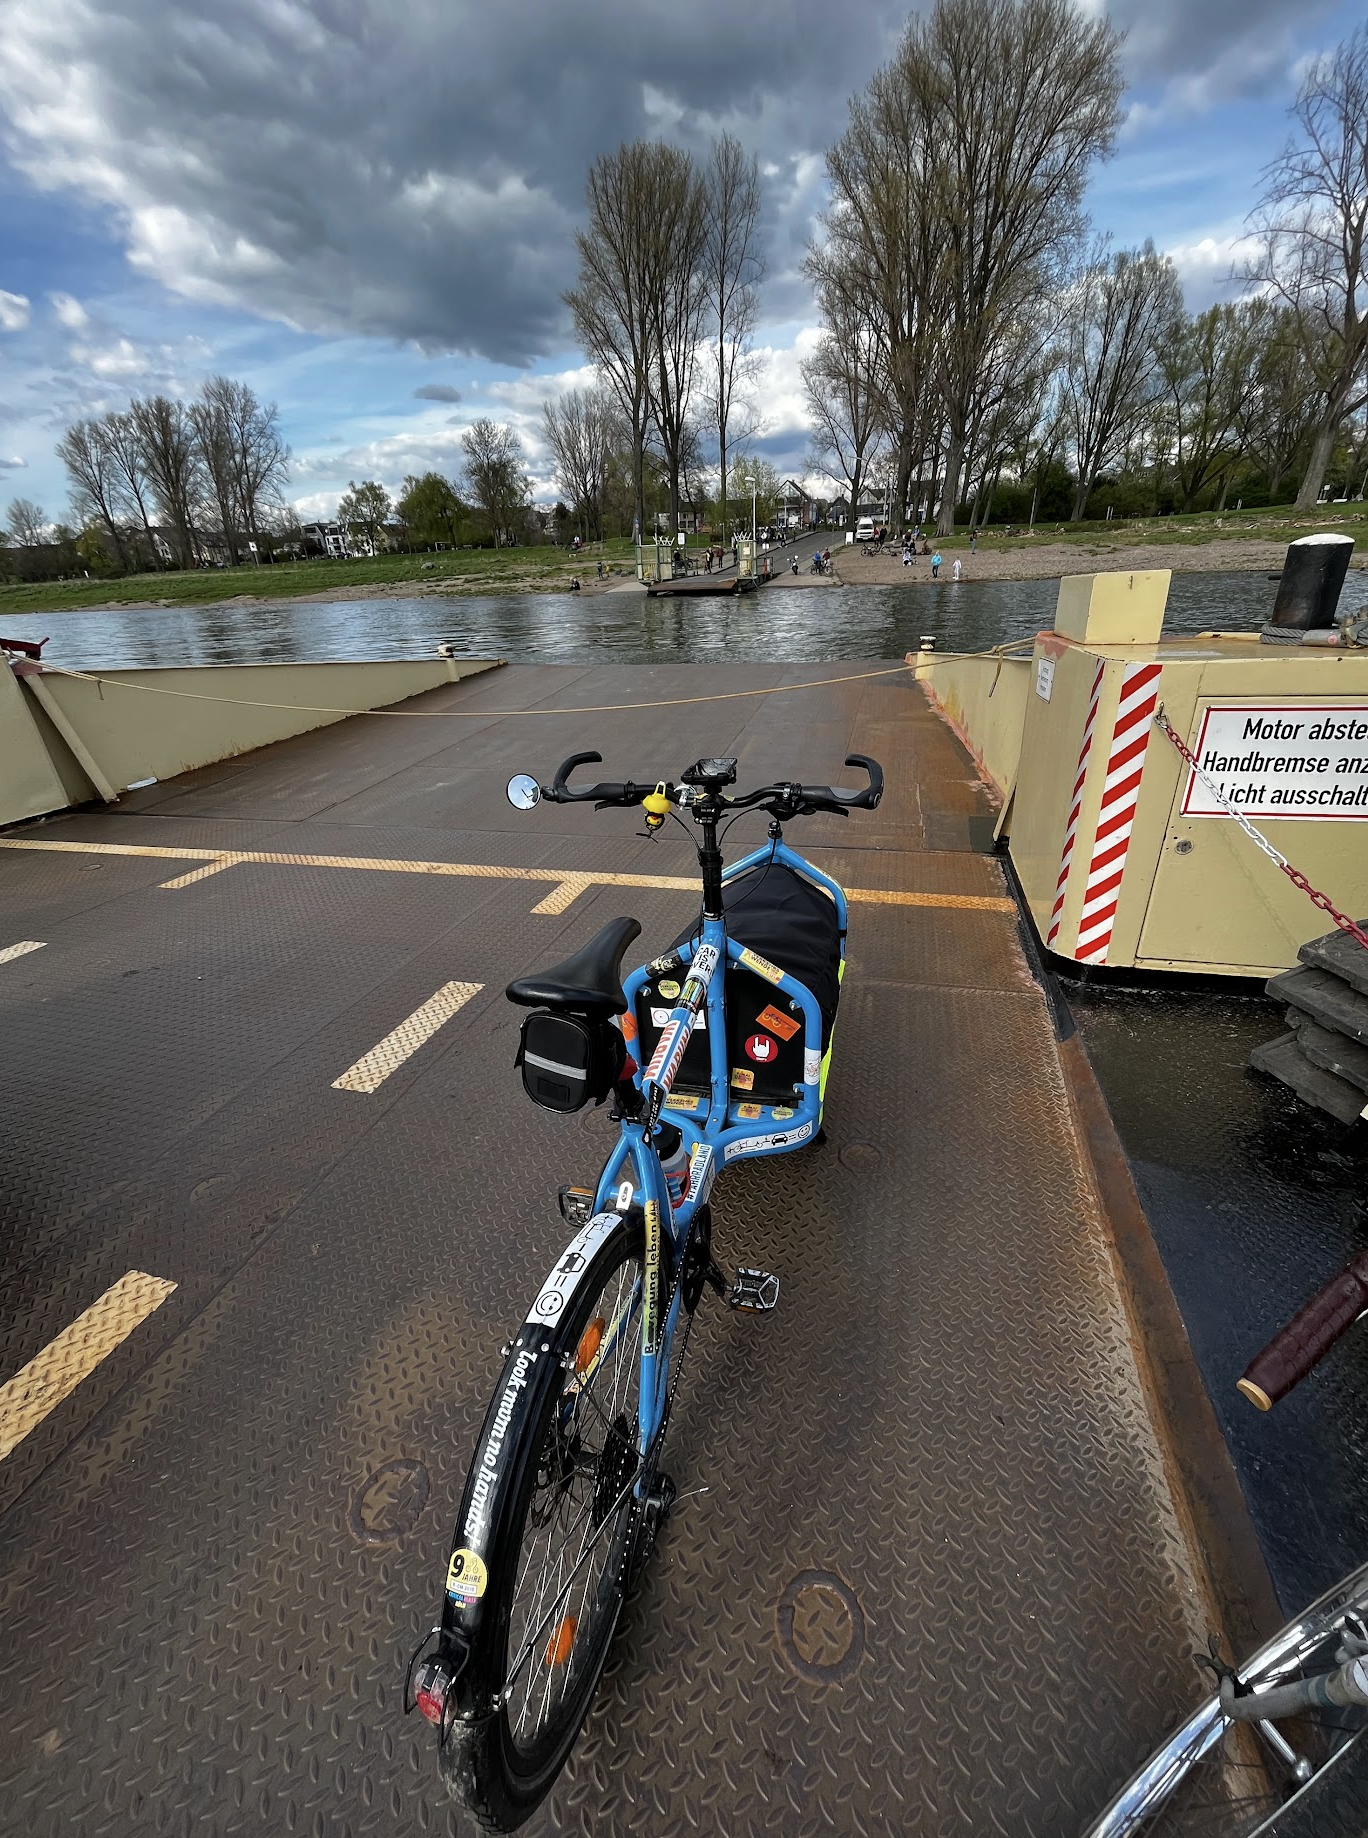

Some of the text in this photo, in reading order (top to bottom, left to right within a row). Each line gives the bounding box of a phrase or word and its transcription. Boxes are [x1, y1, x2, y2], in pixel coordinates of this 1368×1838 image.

[1242, 717, 1368, 740] Motor abste
[1203, 750, 1330, 774] Handbremse
[697, 947, 716, 960] CAR
[698, 954, 708, 962] IS
[490, 1388, 518, 1439] mum
[484, 1438, 501, 1467] no
[450, 1554, 465, 1578] 9
[462, 1573, 482, 1583] JAHRE
